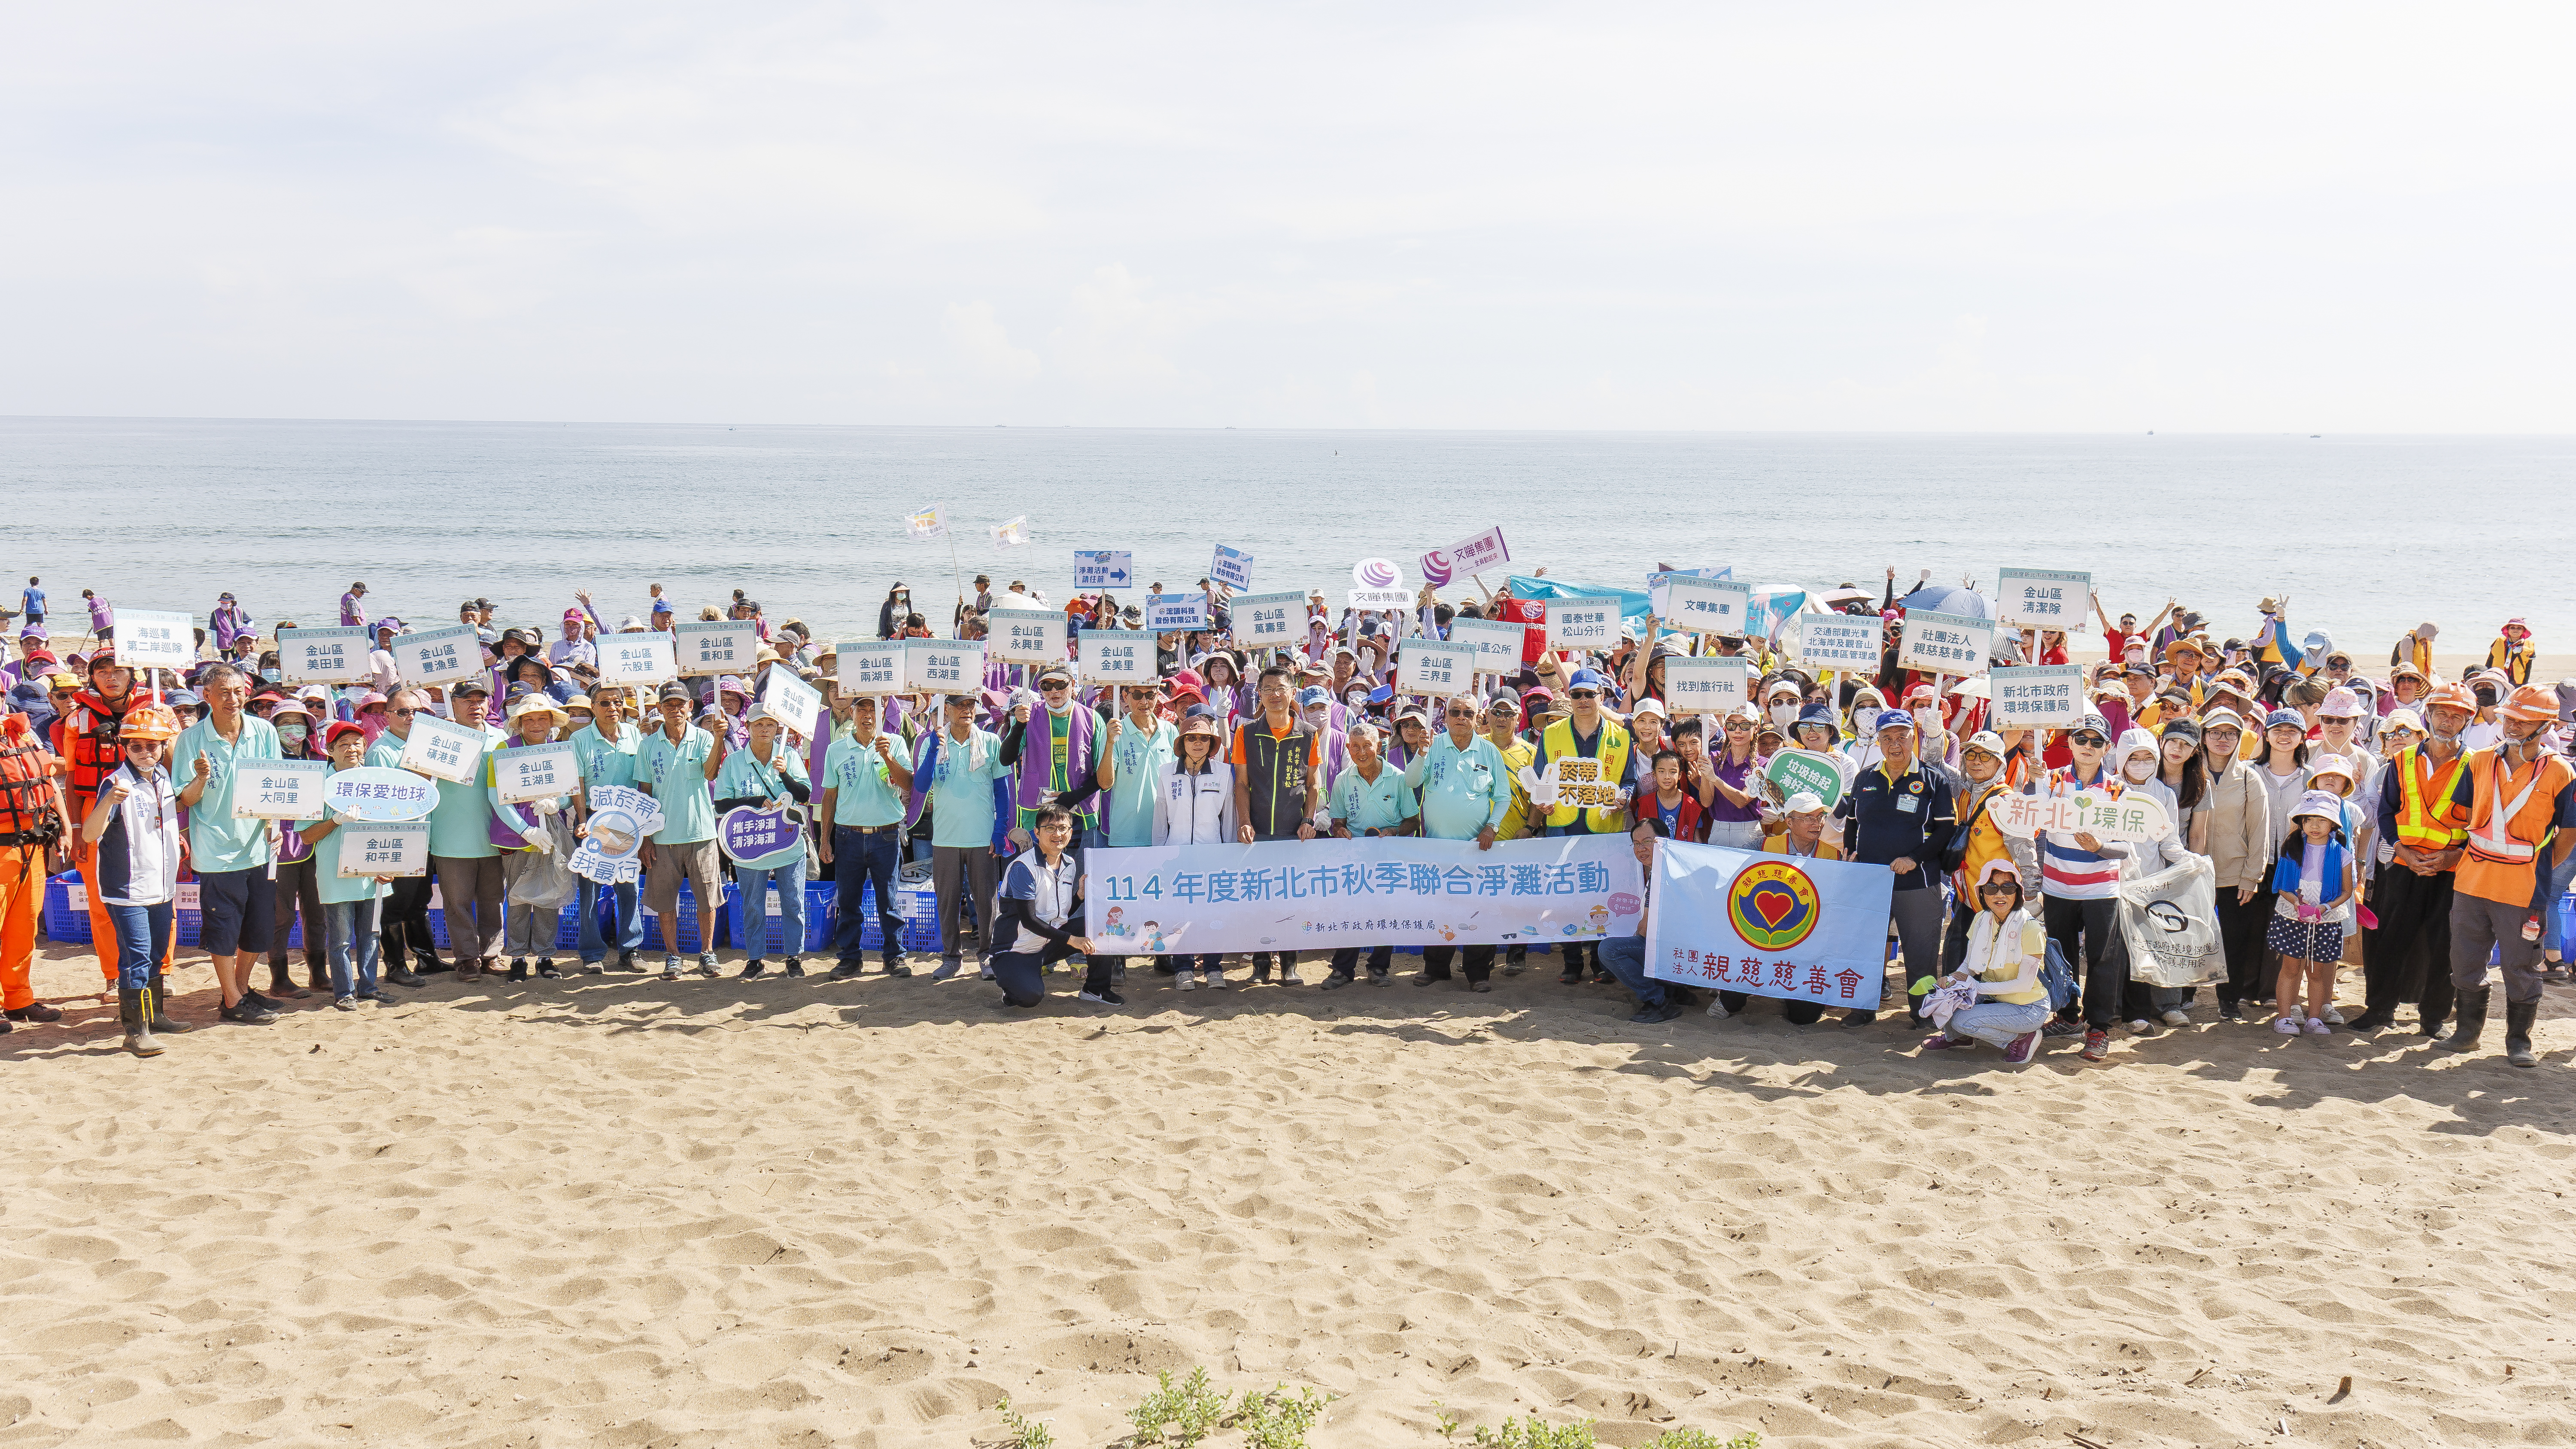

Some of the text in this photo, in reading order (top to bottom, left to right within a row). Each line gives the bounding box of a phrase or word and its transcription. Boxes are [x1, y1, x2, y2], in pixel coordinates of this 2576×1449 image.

[1453, 535, 1496, 563] 文曄集團
[1474, 552, 1499, 567] 全員動起來
[1079, 566, 1109, 574] 淨灘活動
[1216, 568, 1244, 583] 股份有限公司
[2002, 571, 2088, 582] 114年度新北市秋季聯合淨灘活動
[1082, 575, 1104, 583] 請往前
[1673, 577, 1748, 592] 114年度新北市秋季聯合淨灘活動
[1232, 593, 1304, 606] 114年度新北市秋季聯合淨灘活動
[1354, 592, 1408, 602] 文曄集團
[2024, 586, 2063, 600] 金山區
[1684, 599, 1730, 614] 文曄集團
[2022, 601, 2061, 615] 清潔隊
[991, 611, 1065, 620] 114年度新北市秋季聯合淨灘活動
[1155, 615, 1198, 624] 股份有限公司
[1253, 608, 1286, 620] 金山區
[1562, 613, 1605, 623] 國泰世華
[678, 623, 753, 632] 114年度新北市秋季聯合淨灘活動
[1454, 622, 1524, 631] 114年度新北市秋季聯合淨灘活動
[1804, 617, 1881, 626] 114年度新北市秋季聯合淨灘活動
[1909, 613, 1993, 629] 114年度新北市秋季聯合淨灘活動
[138, 627, 170, 639] 海巡署
[281, 629, 366, 639] 114年度新北市秋季聯合淨灘活動
[1011, 625, 1044, 637] 金山區
[1254, 621, 1287, 635] 萬壽里
[1562, 626, 1605, 637] 松山分行
[1814, 627, 1869, 638] 交通部觀光署
[394, 627, 473, 645] 114年度新北市秋季聯合淨灘活動
[700, 637, 733, 648] 金山區
[1921, 629, 1972, 646] 社團法人
[127, 640, 182, 653] 第二岸巡隊
[306, 644, 343, 655] 金山區
[908, 642, 982, 650] 114年度新北市秋季聯合淨灘活動
[1011, 638, 1044, 650] 永興里
[1403, 641, 1474, 651] 114年度新北市秋季聯合淨灘活動
[1463, 640, 1512, 656] 區公所
[1808, 638, 1872, 649] 北海岸及觀音山
[419, 644, 456, 659] 金山區
[620, 648, 652, 659] 金山區
[700, 649, 734, 662] 重和里
[1101, 646, 1134, 657] 金山區
[1803, 647, 1877, 661] 國家風景區管理處
[1913, 642, 1977, 661] 親慈慈善會
[307, 657, 344, 670] 美田里
[422, 658, 458, 673] 豐漁里
[622, 660, 653, 672] 六股里
[860, 657, 893, 669] 金山區
[927, 655, 961, 666] 金山區
[1101, 659, 1134, 671] 金美里
[1421, 656, 1453, 668] 金山區
[860, 670, 893, 682] 兩湖里
[927, 668, 960, 680] 西湖里
[1419, 669, 1451, 683] 三界里
[1993, 667, 2080, 678] 114年度新北市秋季聯合淨灘活動
[1677, 680, 1734, 693] 找到旅行社
[2003, 683, 2069, 698] 新北市政府
[783, 687, 805, 707] 金山區
[781, 699, 802, 719] 清泉里
[2004, 699, 2069, 713] 環境保護局
[417, 715, 488, 741] 114年度新北市秋季聯合淨灘活動
[431, 735, 463, 753] 金山區
[426, 748, 458, 766] 磺港里
[496, 744, 572, 759] 114年度新北市秋季聯合淨灘活動
[238, 762, 324, 770] 114年度新北市秋季聯合淨灘活動
[519, 760, 553, 774] 金山區
[1559, 761, 1598, 782] 菸蒂
[521, 774, 555, 787] 五湖里
[1786, 758, 1832, 790] 垃圾撿起
[261, 777, 299, 789] 金山區
[260, 792, 298, 804] 大同里
[336, 781, 426, 802] 環保愛地球
[1558, 784, 1616, 806] 不落地
[594, 789, 657, 819] 減菸蒂
[732, 818, 776, 833] 攜手淨灘
[366, 838, 404, 849] 金山區
[732, 832, 776, 848] 清淨海灘
[365, 851, 402, 863] 和平里
[573, 851, 640, 882] 我最行
[1106, 860, 1609, 903] 114 年度新北市秋季聯合淨灘活動
[1742, 868, 1810, 897] 親慈慈善會
[1315, 919, 1436, 933] 新北市政府環境保護局
[1673, 947, 1698, 963] 社團
[1673, 962, 1698, 976] 法人
[1702, 951, 1864, 999] 親慈慈善會
